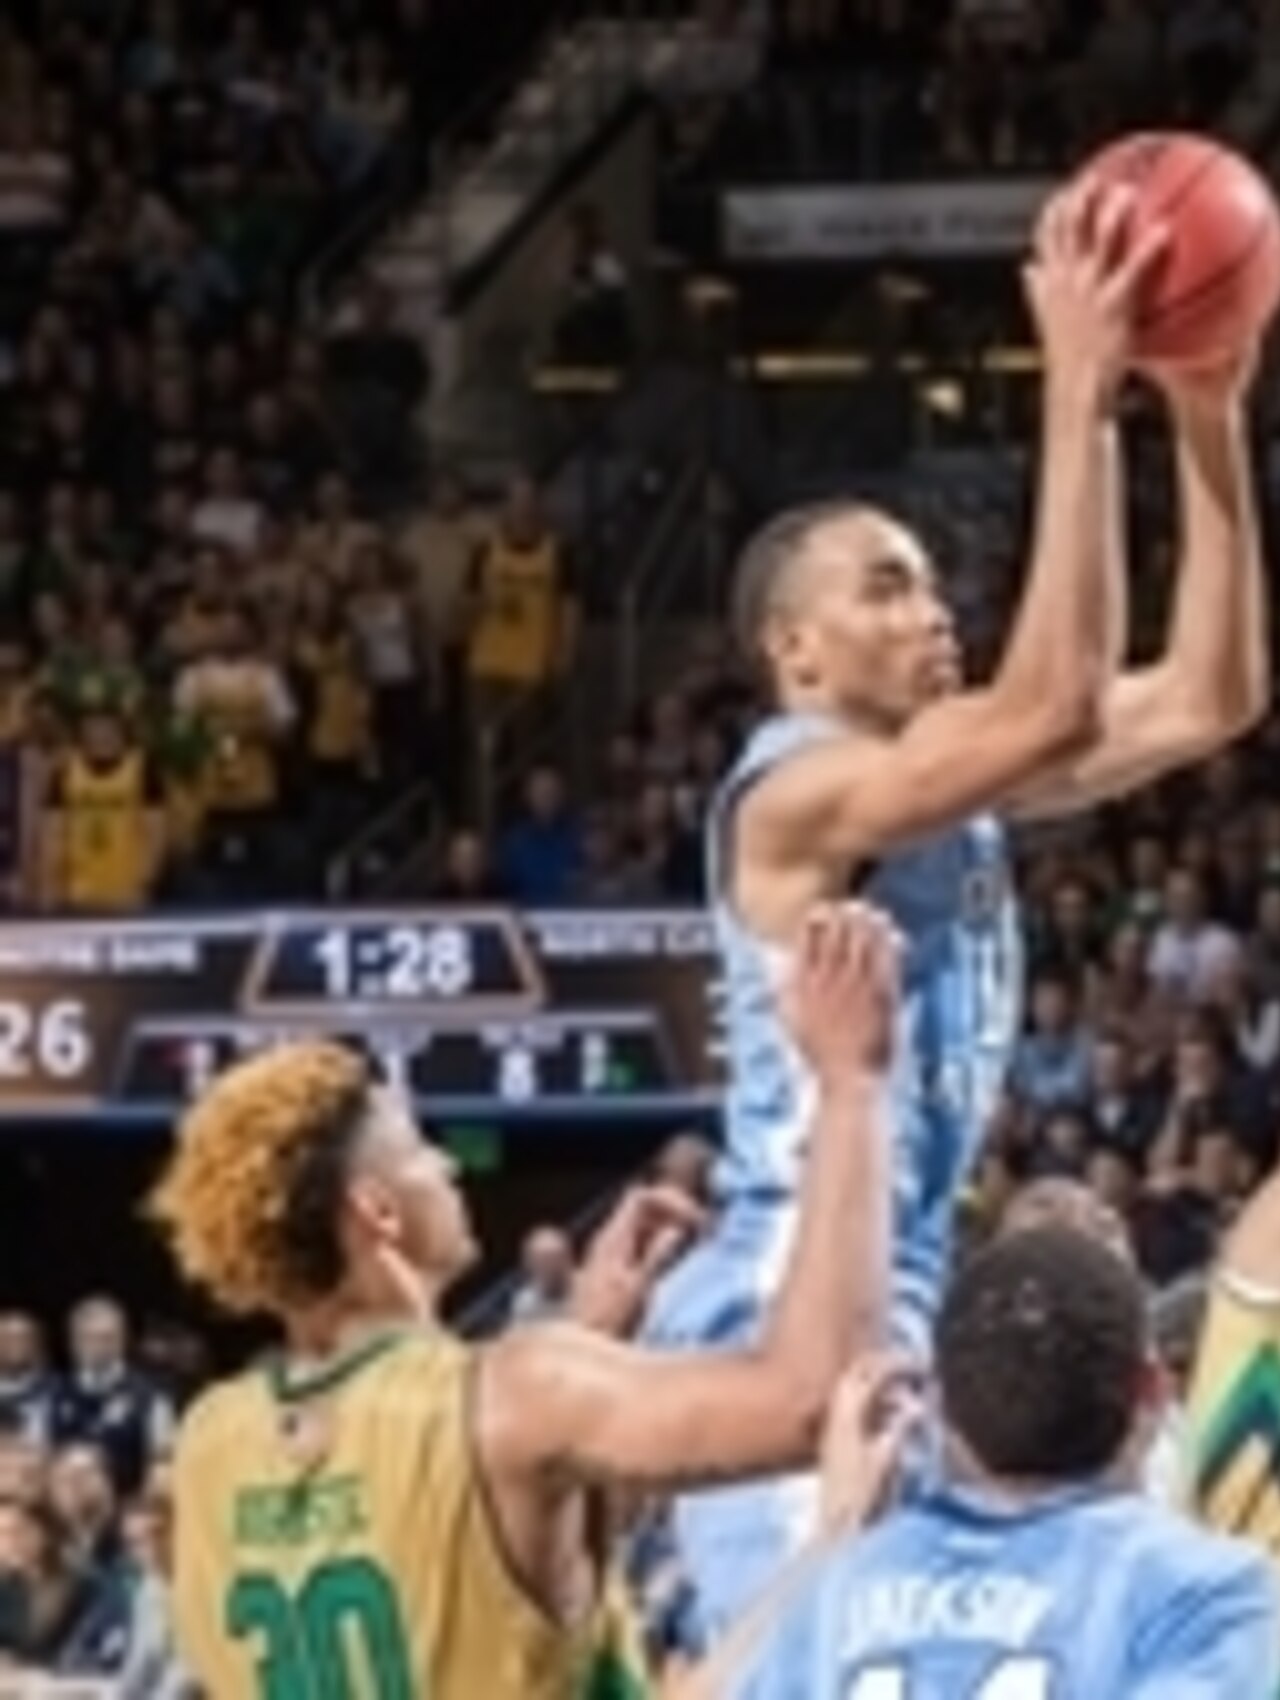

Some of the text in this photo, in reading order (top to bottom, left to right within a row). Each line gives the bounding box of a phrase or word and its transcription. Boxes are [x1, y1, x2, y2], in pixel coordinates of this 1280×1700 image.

[315, 927, 474, 996] 1:28
[0, 998, 93, 1079] 26
[226, 1555, 412, 1700] 30
